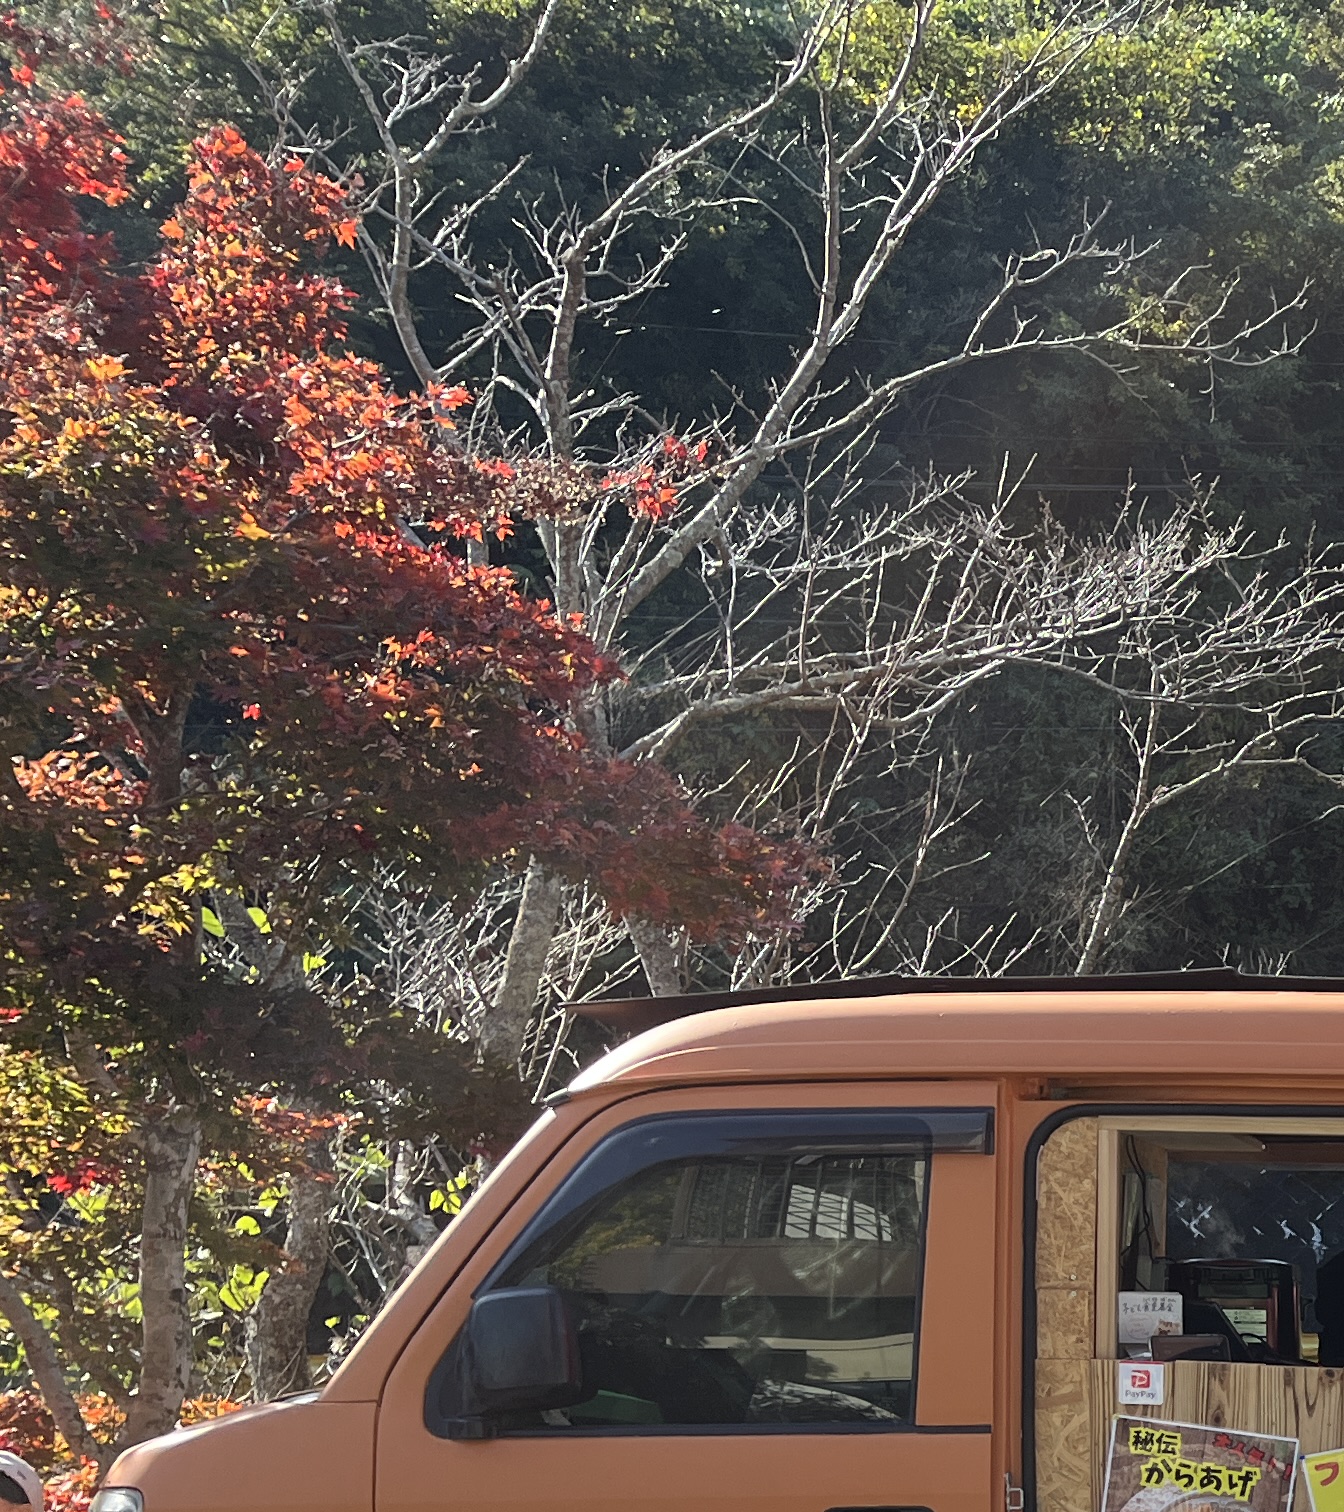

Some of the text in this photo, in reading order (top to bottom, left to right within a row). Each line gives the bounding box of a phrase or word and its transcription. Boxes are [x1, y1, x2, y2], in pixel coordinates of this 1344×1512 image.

[1125, 1389, 1157, 1400] PayPay
[1131, 1428, 1181, 1456] 秘伝
[1144, 1460, 1258, 1497] からあげ
